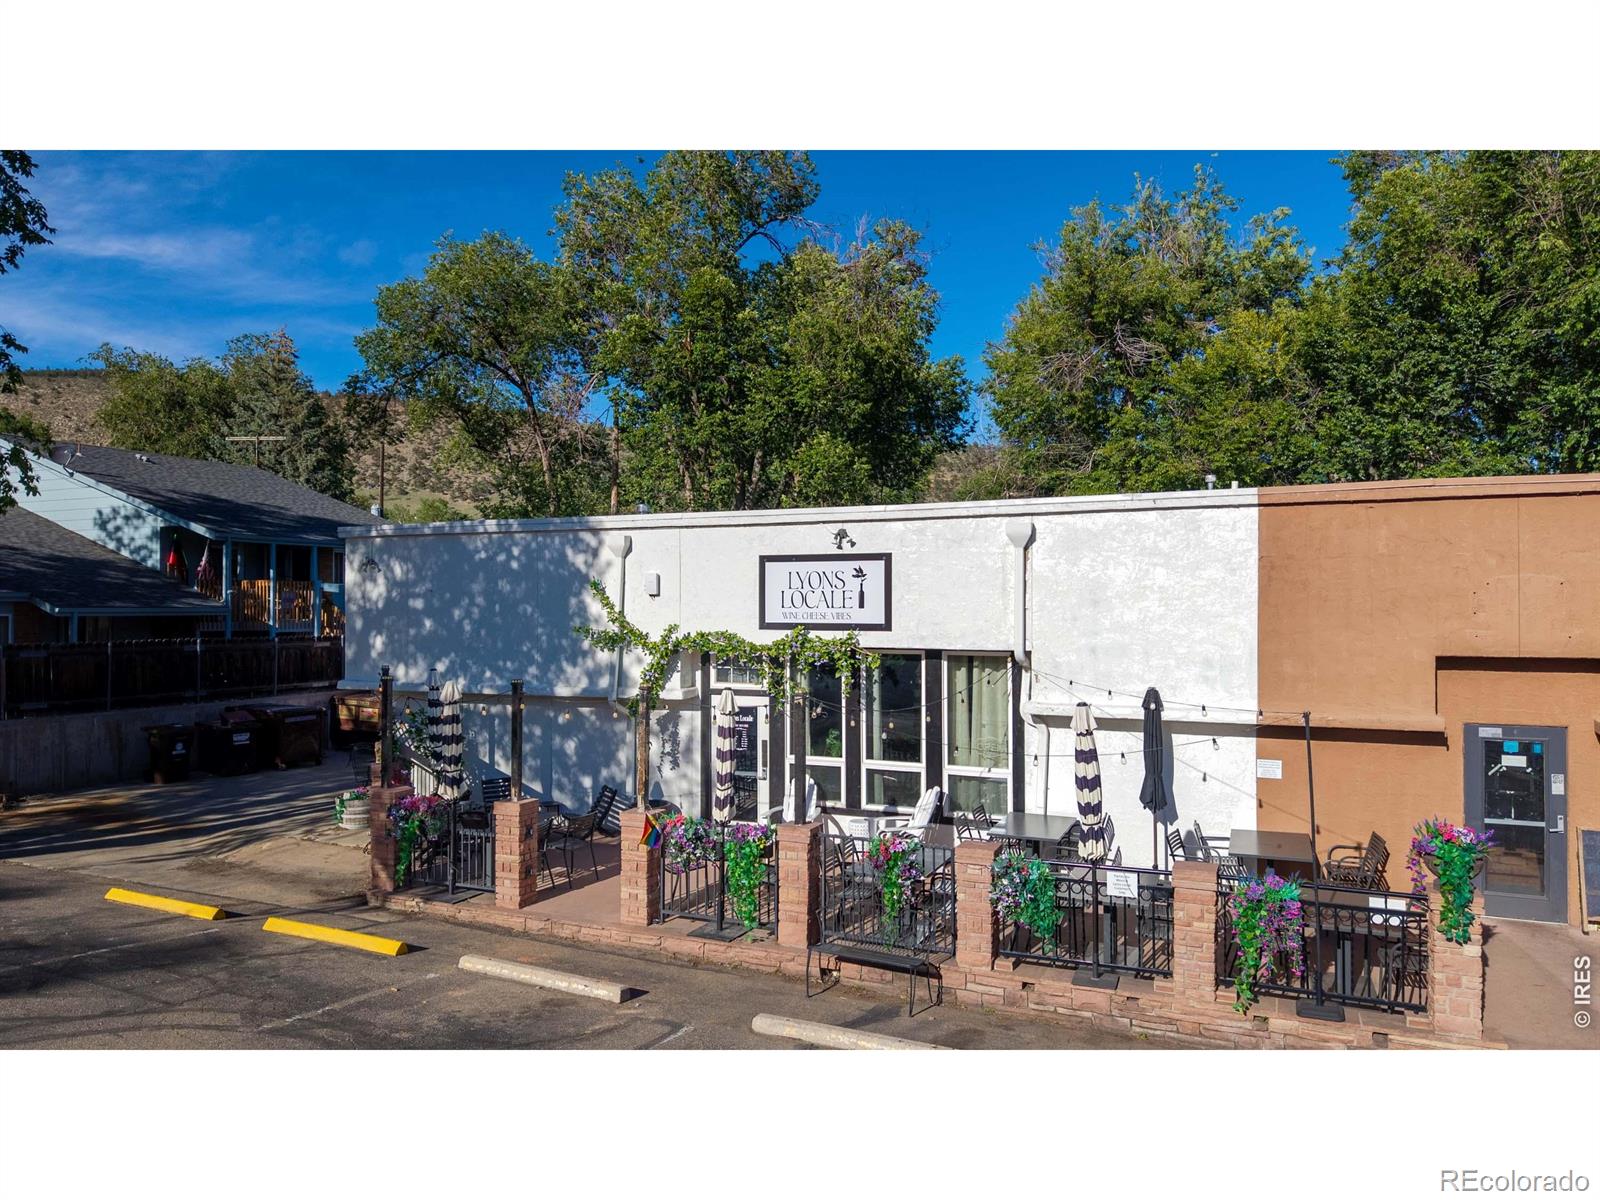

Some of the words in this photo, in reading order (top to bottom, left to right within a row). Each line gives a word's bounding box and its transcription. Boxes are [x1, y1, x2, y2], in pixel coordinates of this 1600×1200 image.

[788, 570, 846, 590] LYONS
[781, 590, 853, 609] LOCALE
[782, 611, 800, 620] WINE
[802, 611, 829, 620] CHEESE
[831, 611, 852, 620] VIBES
